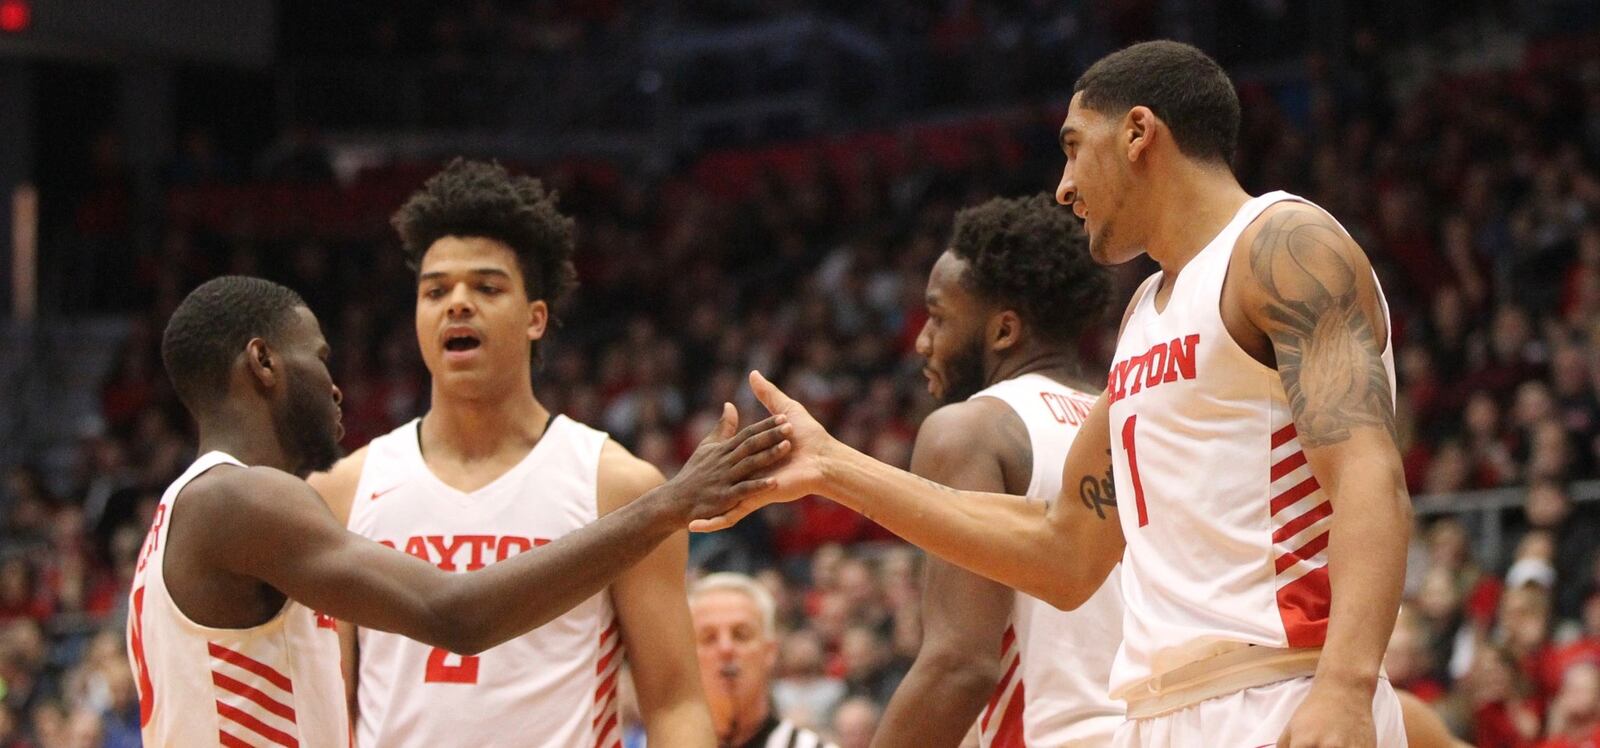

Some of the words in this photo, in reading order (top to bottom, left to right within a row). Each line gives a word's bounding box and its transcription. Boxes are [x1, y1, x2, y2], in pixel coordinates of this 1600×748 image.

[1107, 333, 1200, 405] AYTON
[1121, 414, 1149, 528] 1
[378, 535, 553, 572] AYTO
